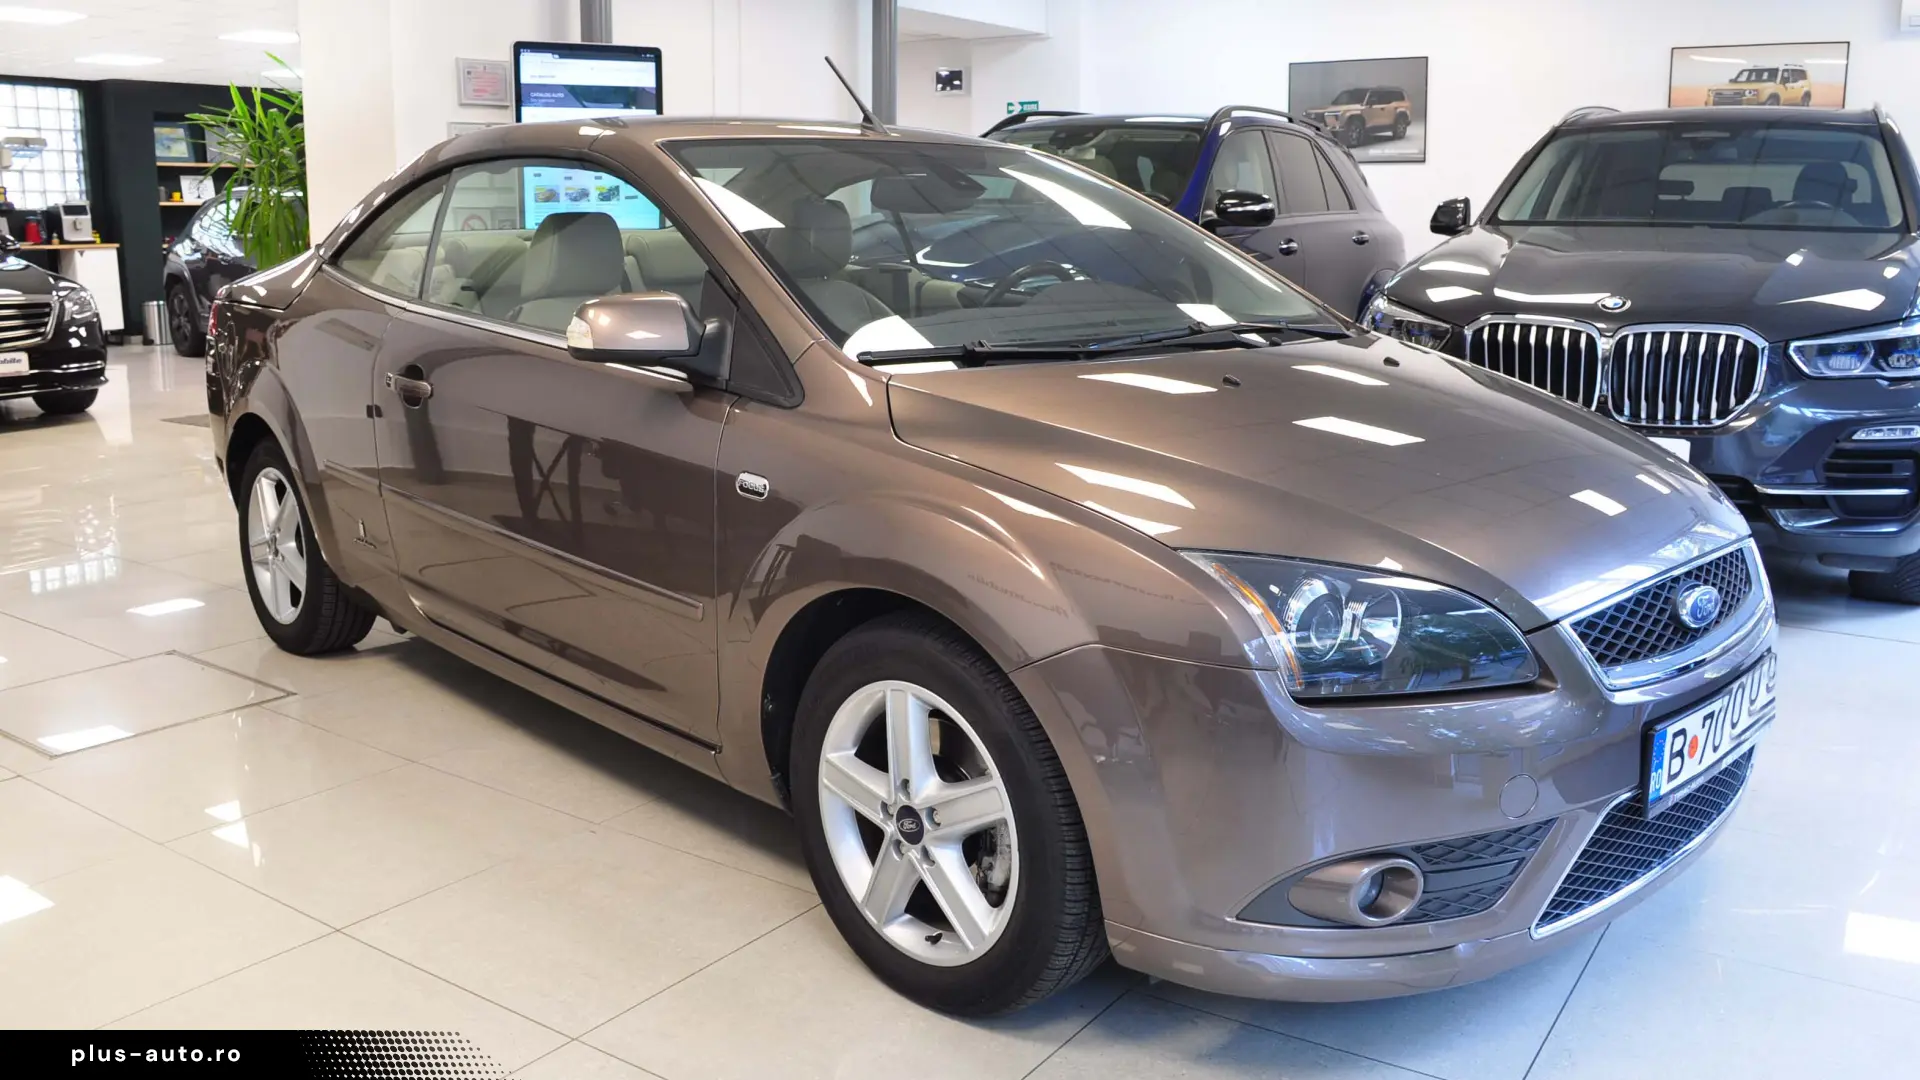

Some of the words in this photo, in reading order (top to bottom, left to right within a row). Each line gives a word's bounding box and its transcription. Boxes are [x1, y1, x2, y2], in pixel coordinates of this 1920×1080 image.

[738, 478, 766, 493] FOCUS
[1667, 727, 1688, 785] B
[1650, 768, 1662, 792] RO
[902, 819, 918, 830] Ford
